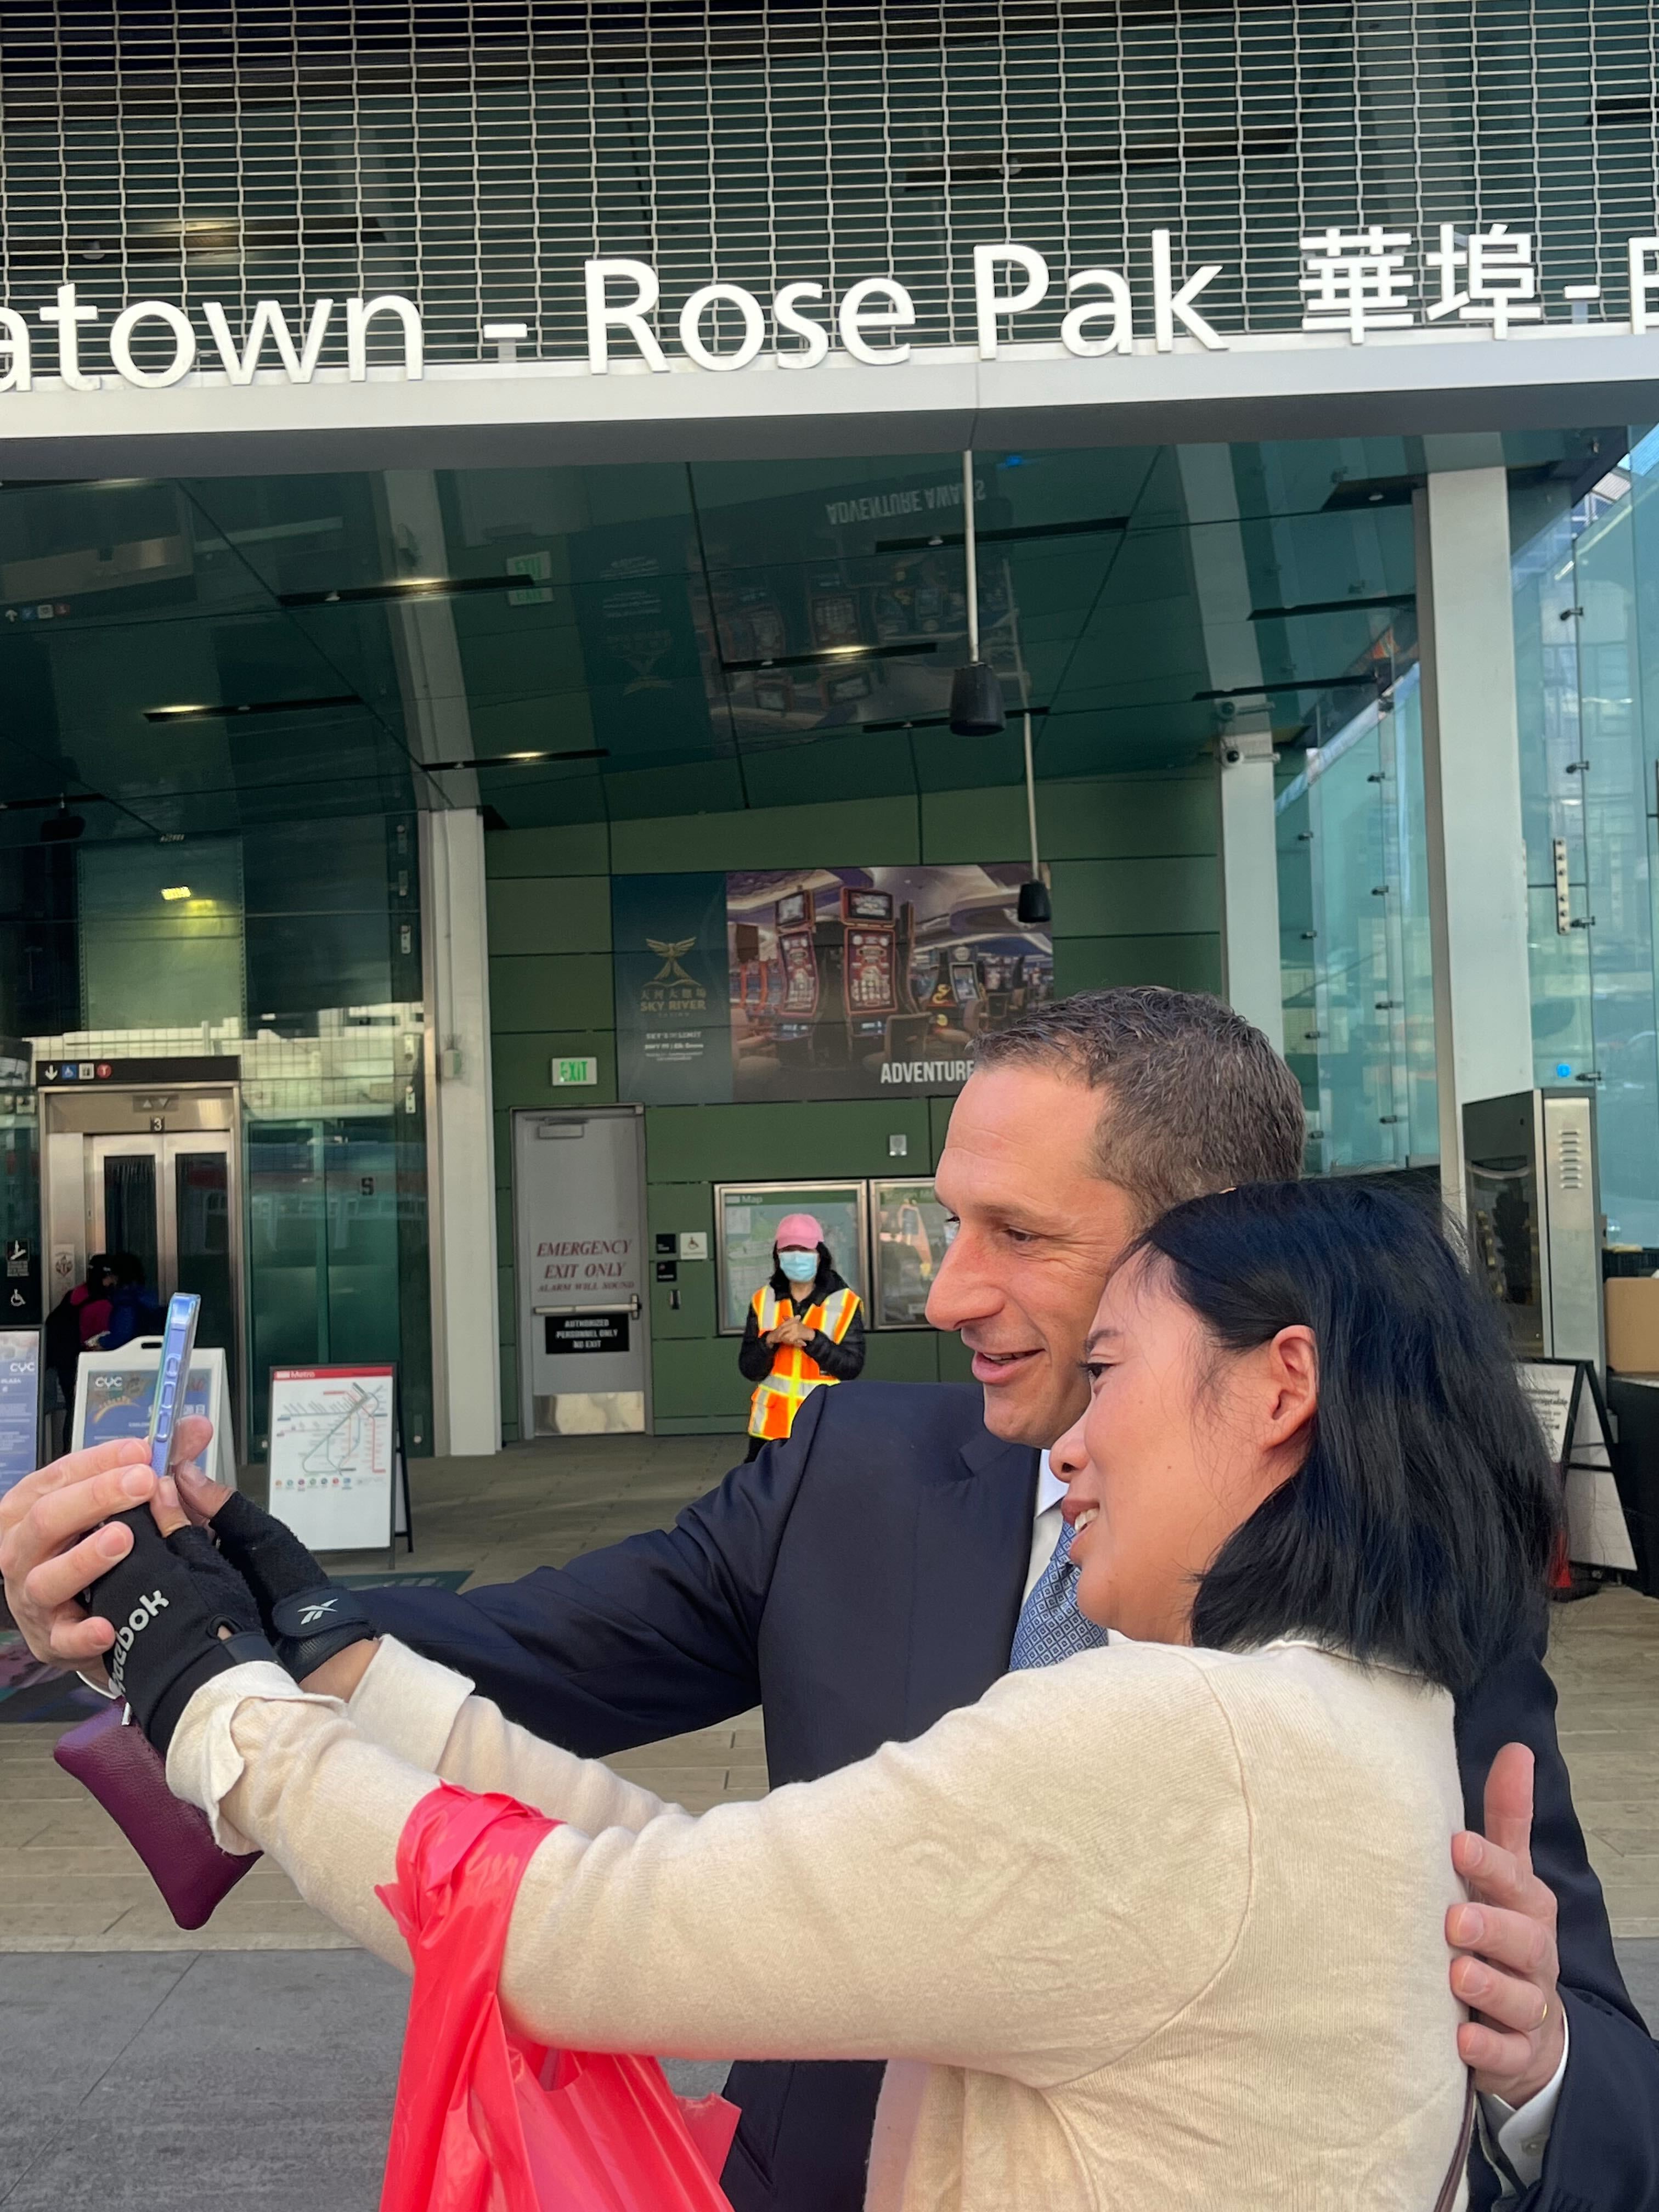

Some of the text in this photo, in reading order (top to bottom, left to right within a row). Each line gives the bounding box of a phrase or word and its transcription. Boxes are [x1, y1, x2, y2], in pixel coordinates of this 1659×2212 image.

[584, 258, 916, 375] Rose
[973, 229, 1229, 360] Pak
[1299, 223, 1541, 345] 華埠
[640, 1000, 707, 1012] SKY RIVER
[560, 1060, 588, 1082] EXIT
[154, 1118, 162, 1131] 3
[537, 1239, 633, 1257] EMERGENCY
[544, 1262, 627, 1279] EXIT ONLY
[537, 1281, 635, 1293] ALARM WILL SOUND
[565, 1319, 610, 1328] AUTHORIZED
[555, 1329, 618, 1339] PERSONNEL ONLY
[573, 1340, 602, 1349] NO EXIT
